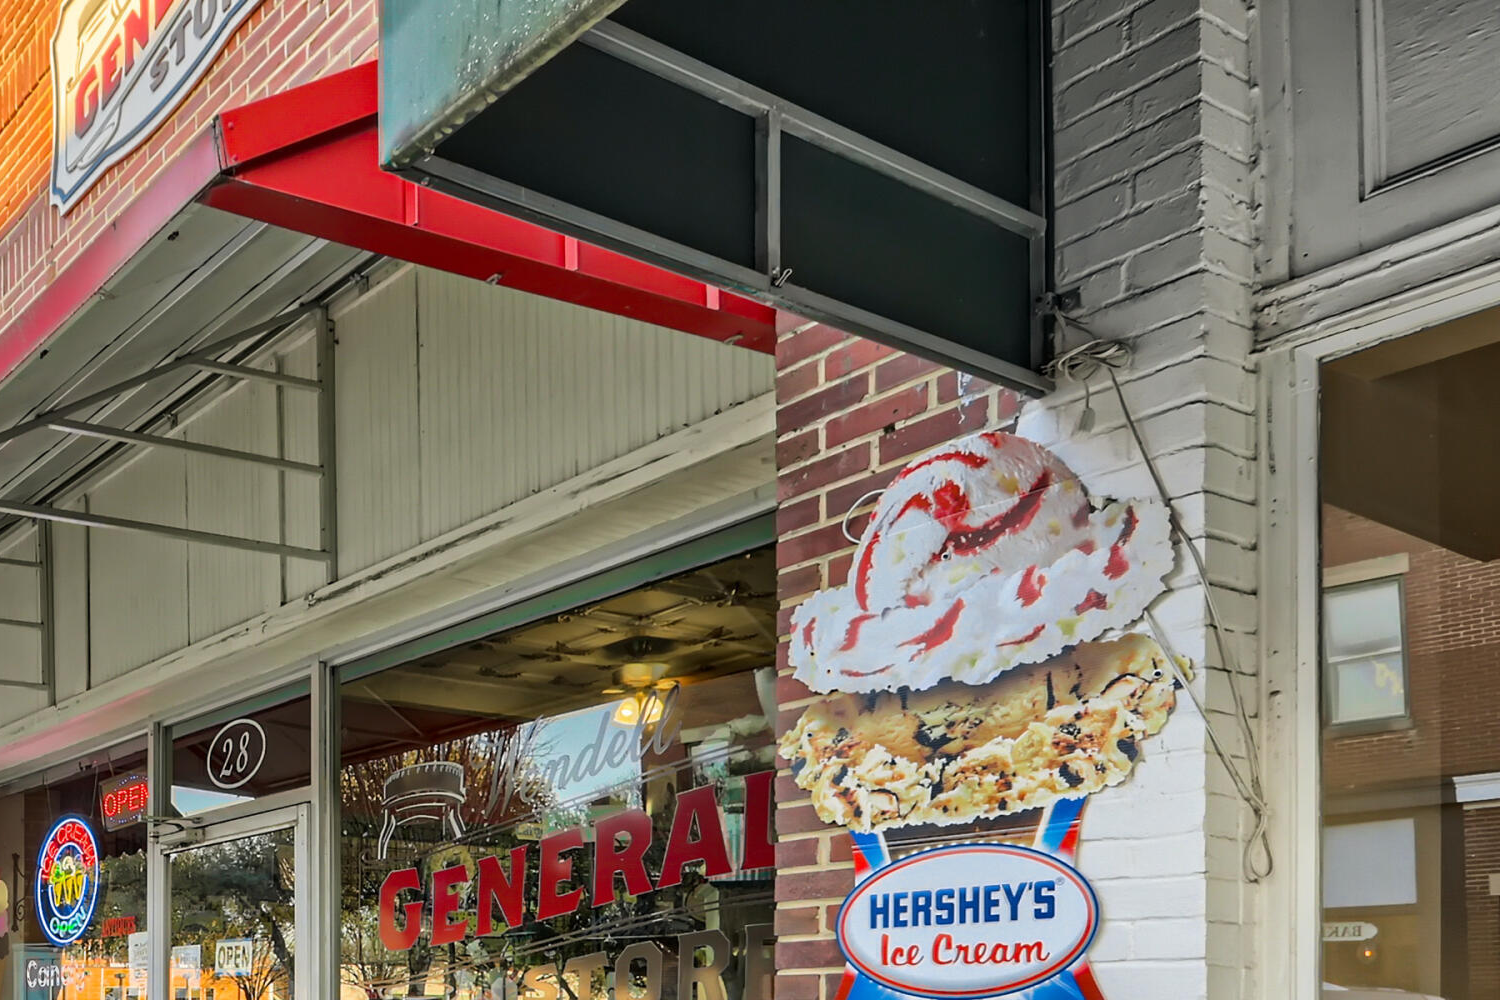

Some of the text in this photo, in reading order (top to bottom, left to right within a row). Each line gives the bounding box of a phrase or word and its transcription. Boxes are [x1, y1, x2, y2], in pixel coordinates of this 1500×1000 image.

[75, 0, 175, 140] GEN
[149, 0, 232, 93] STO
[219, 730, 251, 779] 28
[469, 683, 683, 818] Wendell
[103, 783, 149, 817] OPEN
[41, 823, 96, 881] ICE CREAM
[378, 769, 776, 952] GENERAL
[49, 905, 88, 937] OPEN
[869, 879, 1057, 930] HERSHEY'S
[26, 957, 85, 993] Candy
[218, 945, 250, 969] OPEN
[880, 933, 1051, 967] Ice Cream
